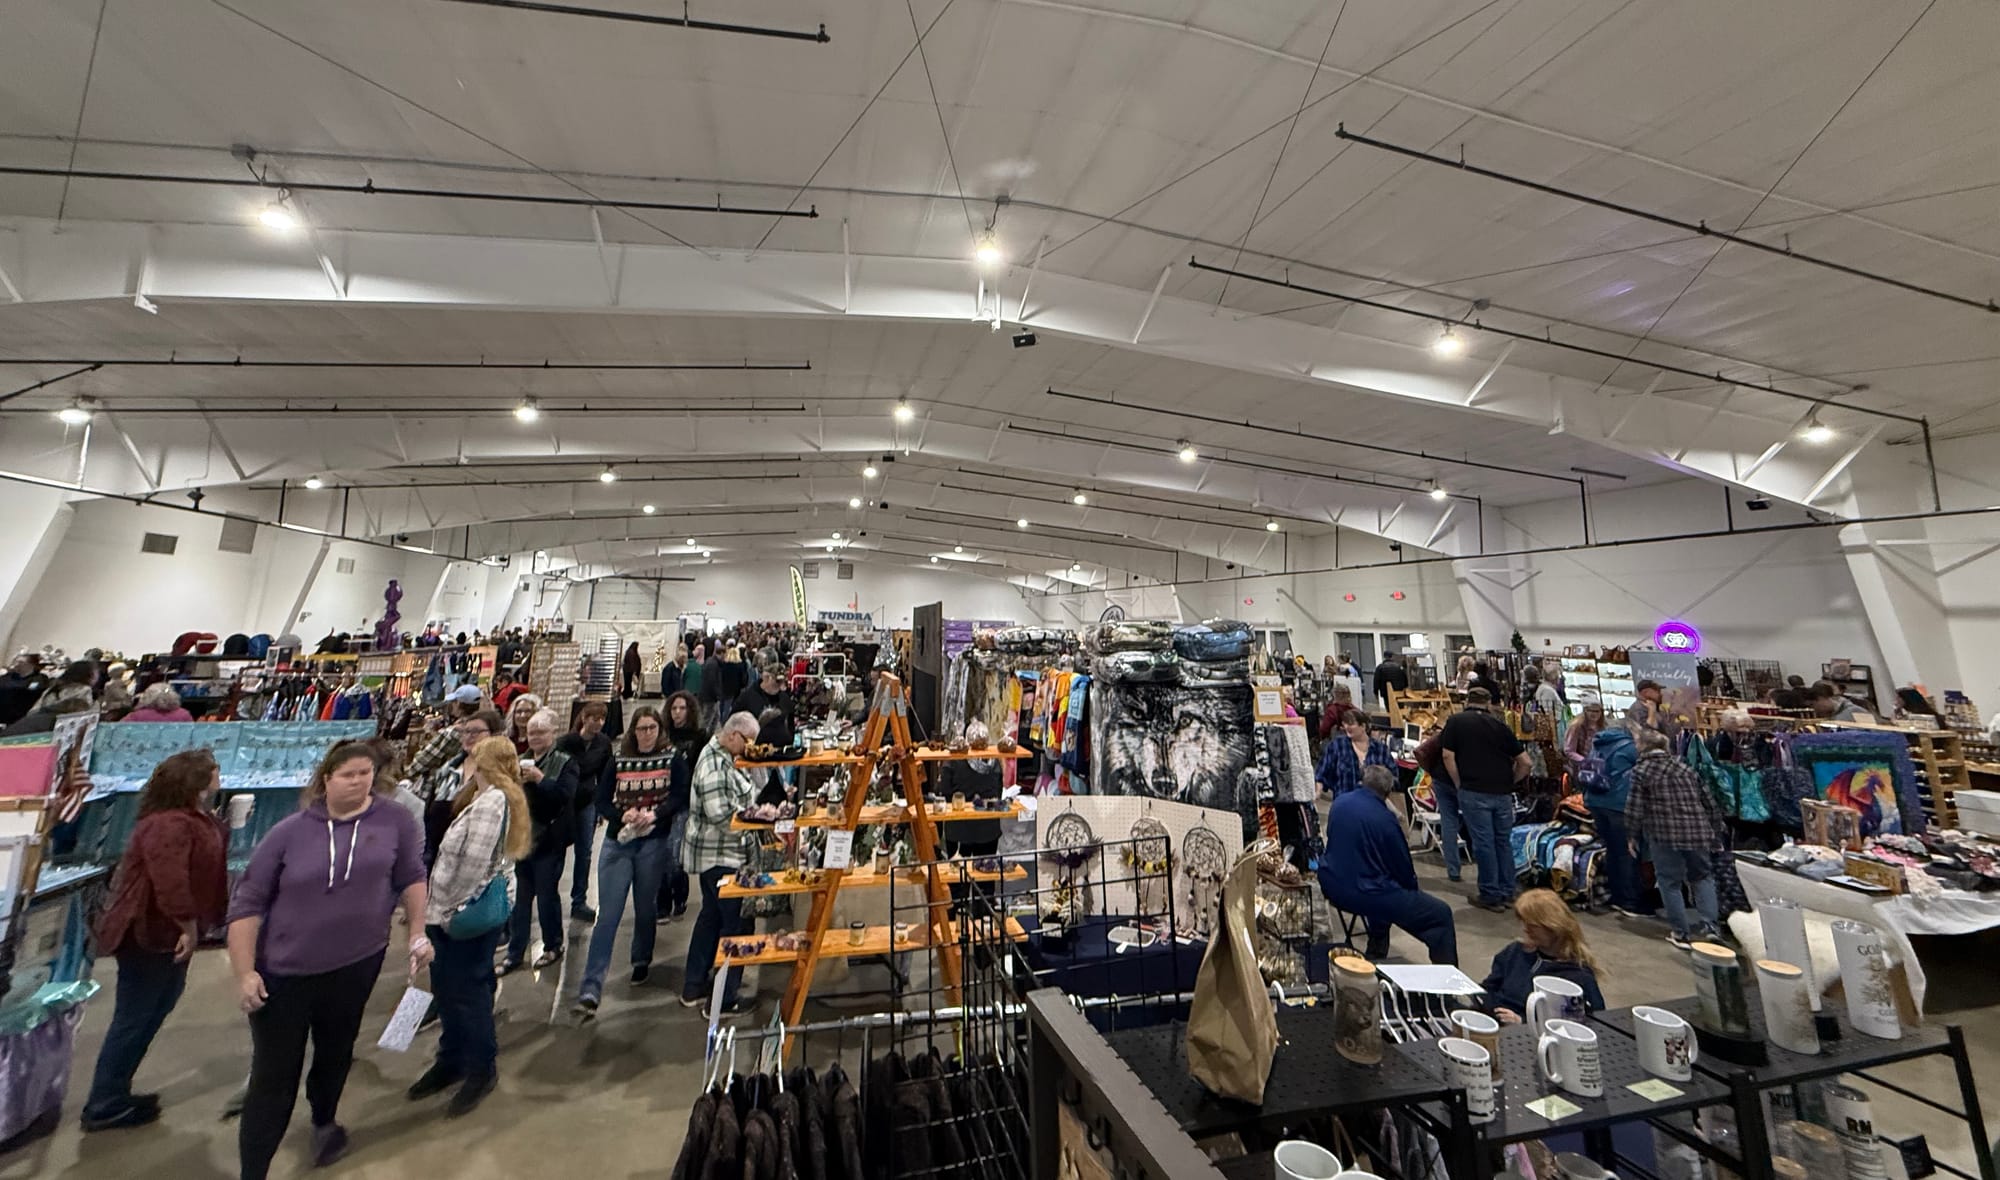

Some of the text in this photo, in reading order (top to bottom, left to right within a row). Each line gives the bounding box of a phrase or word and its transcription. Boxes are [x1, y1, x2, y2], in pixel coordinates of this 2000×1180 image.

[819, 611, 872, 621] TUNDRA
[1637, 669, 1692, 686] Naturally
[1846, 1116, 1873, 1135] RN
